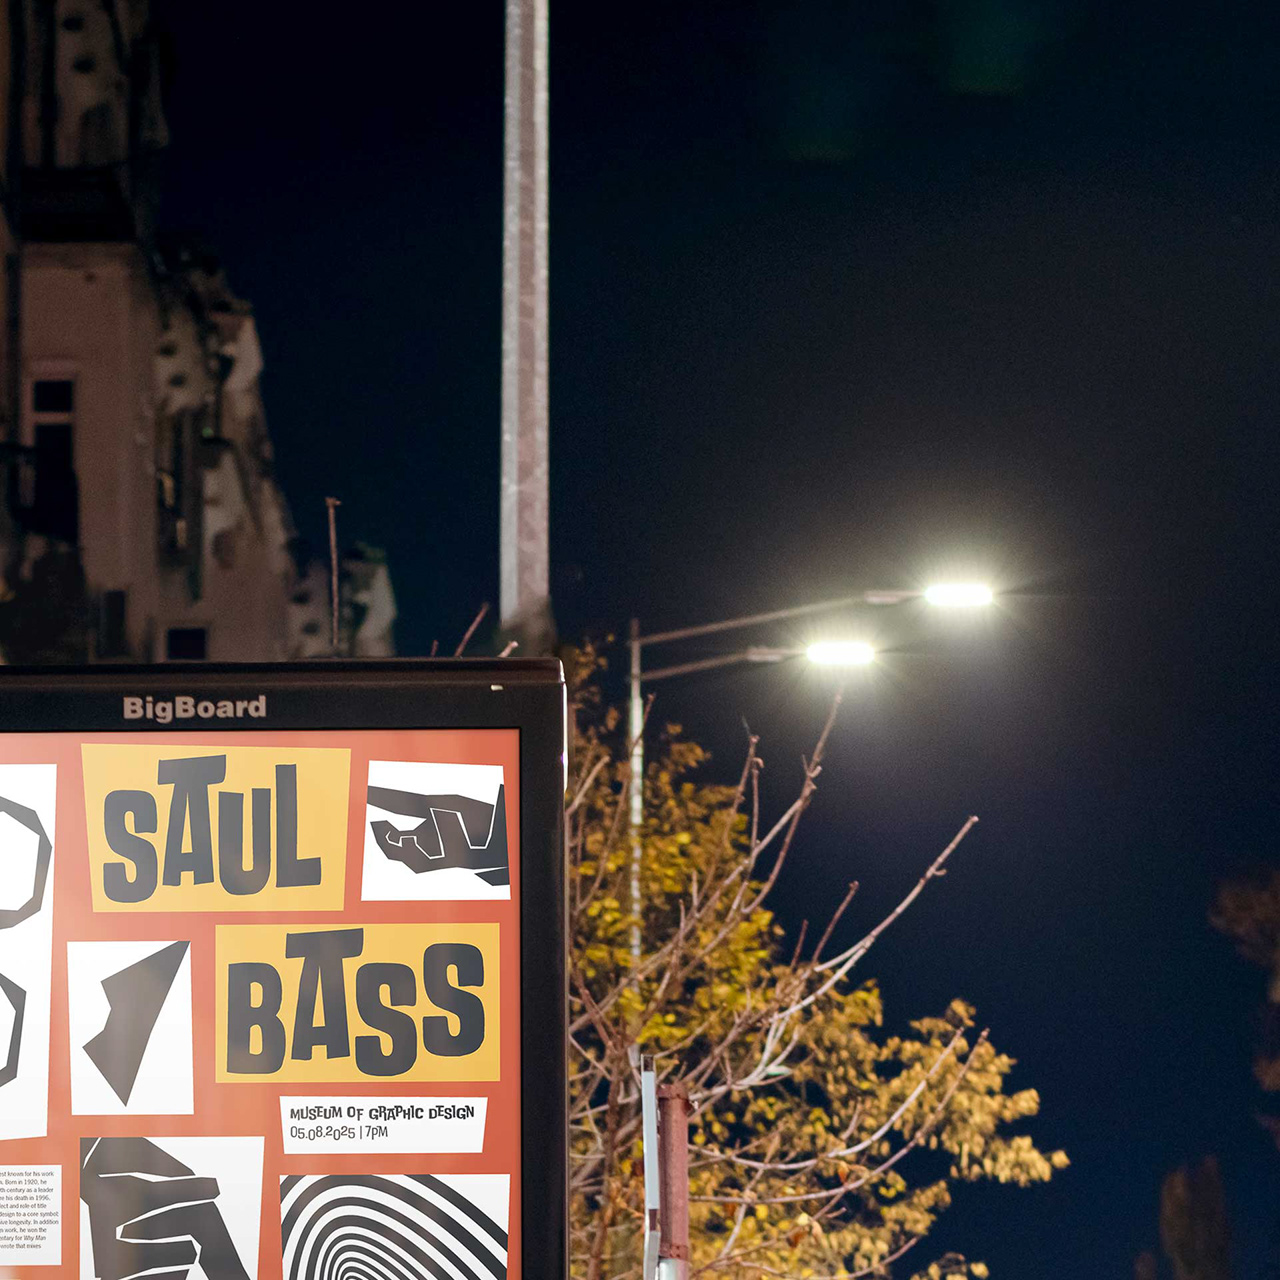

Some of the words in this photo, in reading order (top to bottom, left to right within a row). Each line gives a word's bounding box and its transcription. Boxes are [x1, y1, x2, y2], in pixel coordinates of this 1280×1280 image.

[123, 694, 267, 724] BigBoard
[102, 754, 322, 904] SAUL
[226, 928, 485, 1077] BASS
[290, 1106, 342, 1121] MUSEUM
[347, 1106, 364, 1121] OF
[369, 1105, 424, 1121] GRAPHIC
[428, 1105, 474, 1120] DESIGN
[290, 1125, 355, 1141] 05.08.2025
